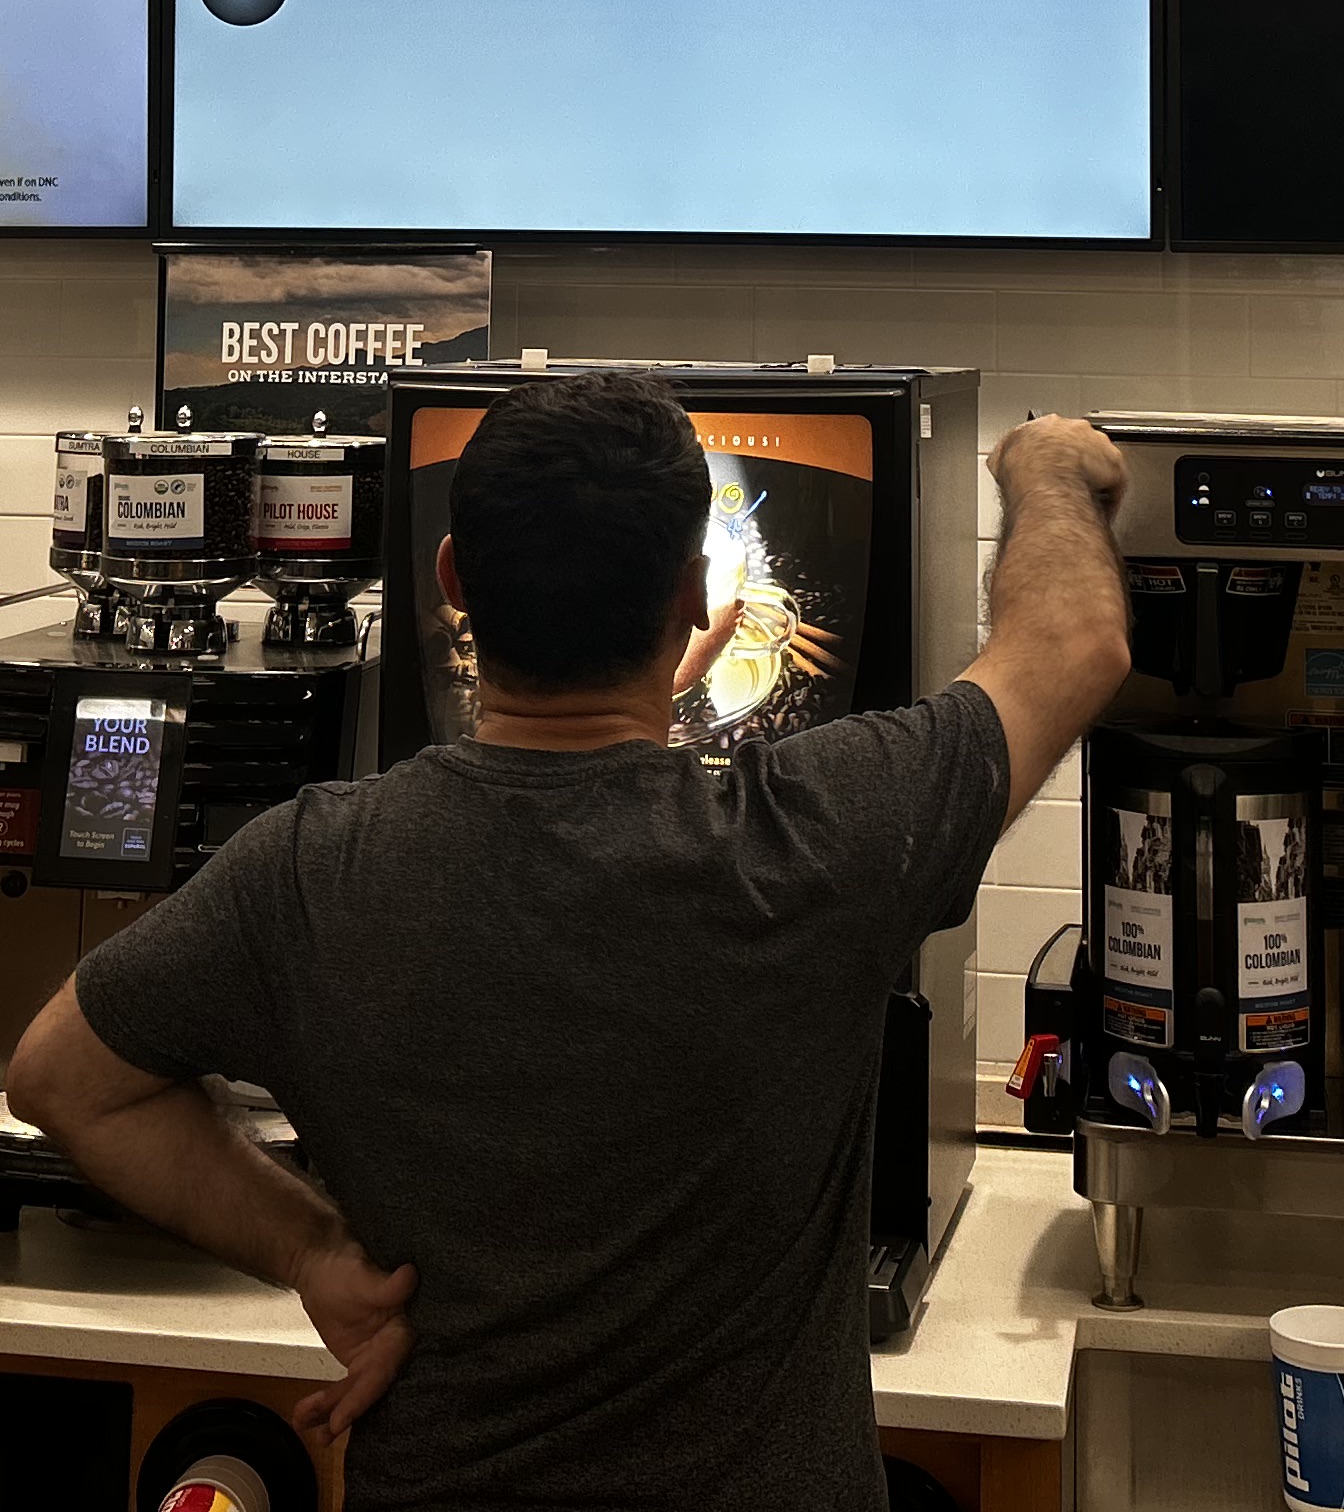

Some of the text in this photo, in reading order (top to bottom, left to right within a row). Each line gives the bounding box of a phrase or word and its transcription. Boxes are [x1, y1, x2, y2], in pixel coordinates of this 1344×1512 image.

[39, 176, 58, 186] DNC
[222, 322, 424, 366] BEST COFFEE
[228, 370, 389, 384] ON THE INTERSTA
[151, 444, 210, 454] COLUMBIAN
[287, 450, 321, 459] HOUSE
[117, 501, 186, 519] COLOMBIAN
[263, 503, 339, 520] PILOT HOUSE
[93, 718, 147, 734] YOUR
[85, 734, 150, 754] BLEND
[3, 839, 25, 848] cycles
[1121, 921, 1144, 939] 100%
[1108, 936, 1162, 961] COLOMBIAN
[1263, 933, 1287, 951] 100%
[1245, 949, 1301, 970] COLOMBIAN
[1294, 1377, 1305, 1421] DRINKS
[1279, 1371, 1310, 1493] pilot
